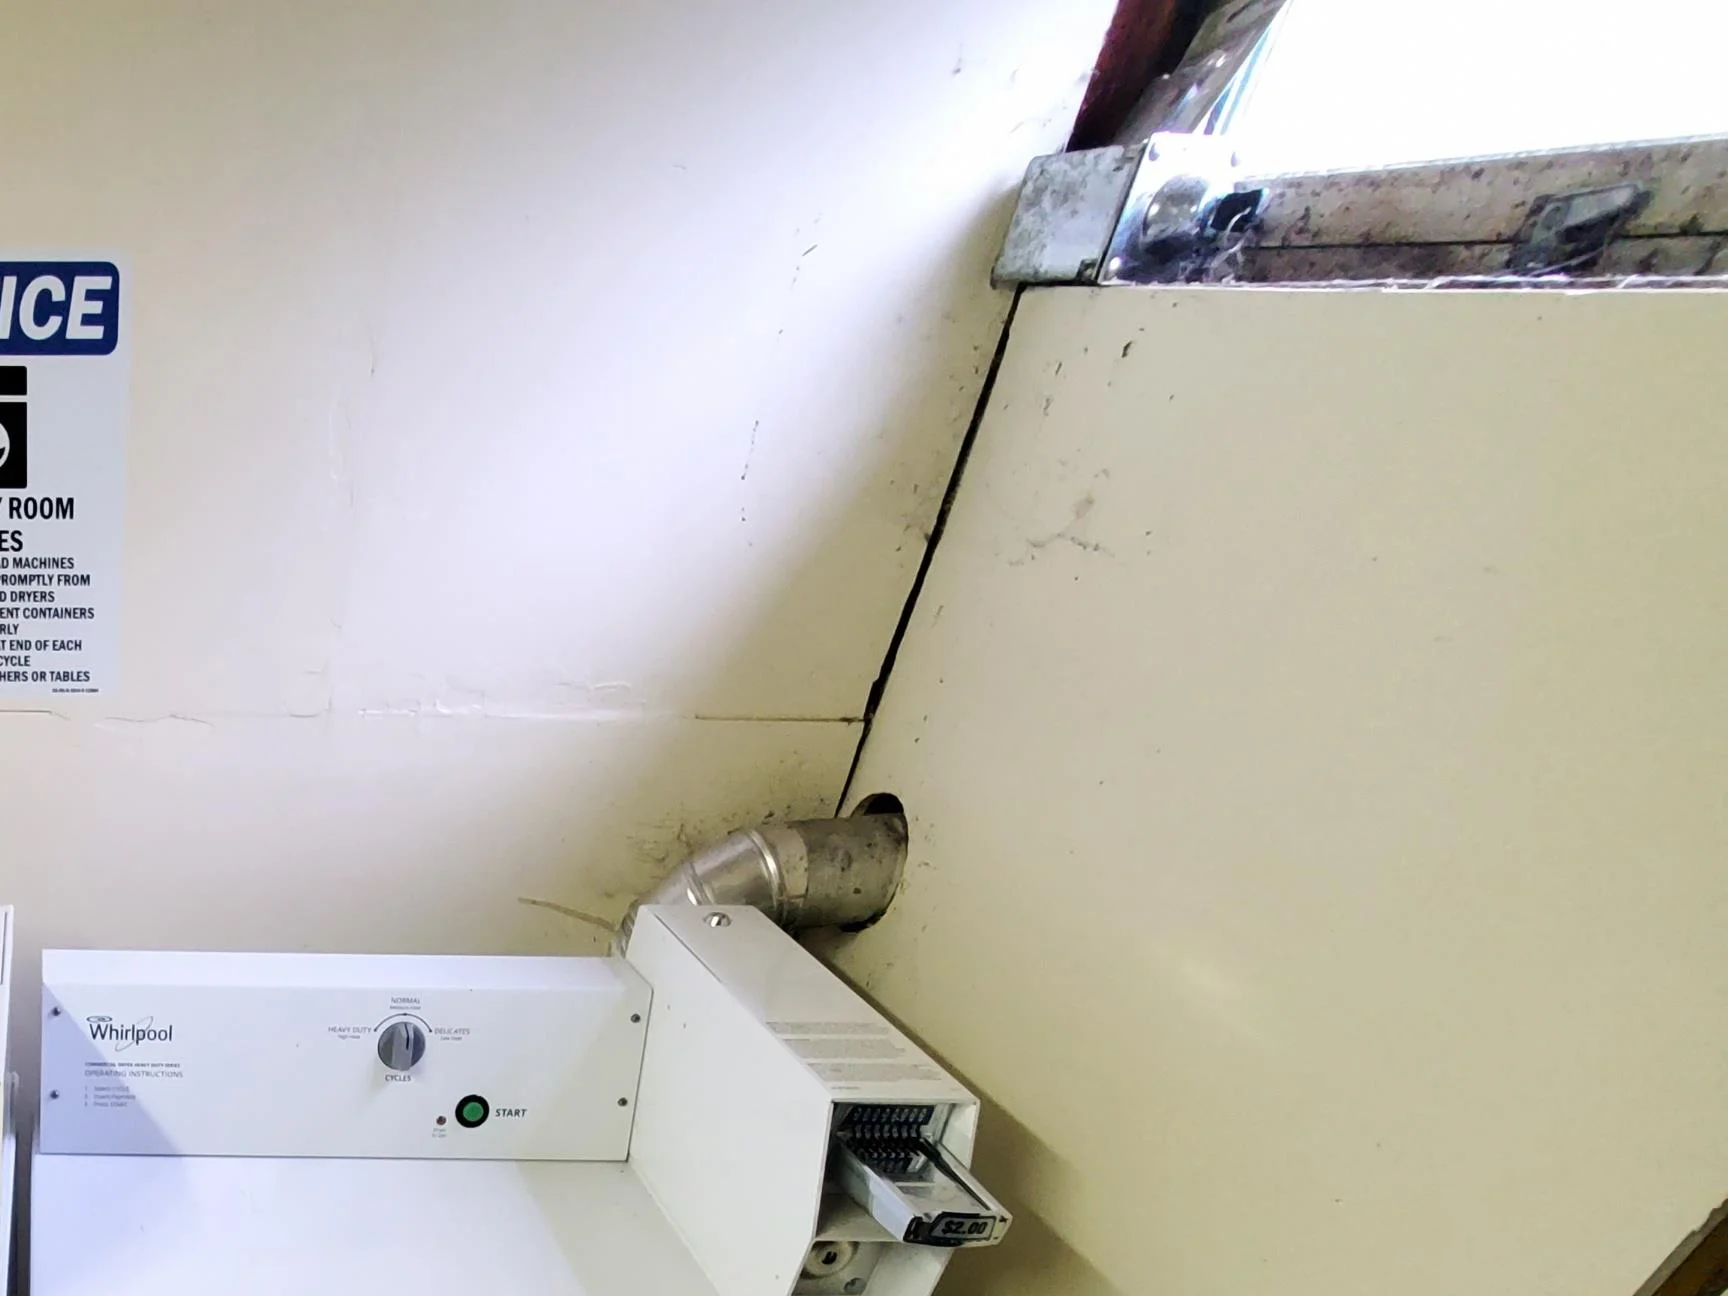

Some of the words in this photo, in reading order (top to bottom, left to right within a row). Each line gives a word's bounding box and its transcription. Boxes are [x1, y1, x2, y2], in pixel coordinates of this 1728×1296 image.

[8, 497, 75, 520] ROOM
[12, 556, 74, 569] MACHINES
[57, 573, 91, 586] FROM
[10, 590, 55, 602] DRYERS
[22, 607, 95, 619] CONTAINERS
[10, 639, 32, 651] END
[35, 639, 49, 651] OF
[52, 639, 82, 651] EACH
[31, 670, 47, 682] OR
[49, 670, 90, 682] TABLES
[89, 1023, 173, 1046] Whirlpool
[495, 1108, 527, 1118] START
[942, 1220, 988, 1234] $2.00
